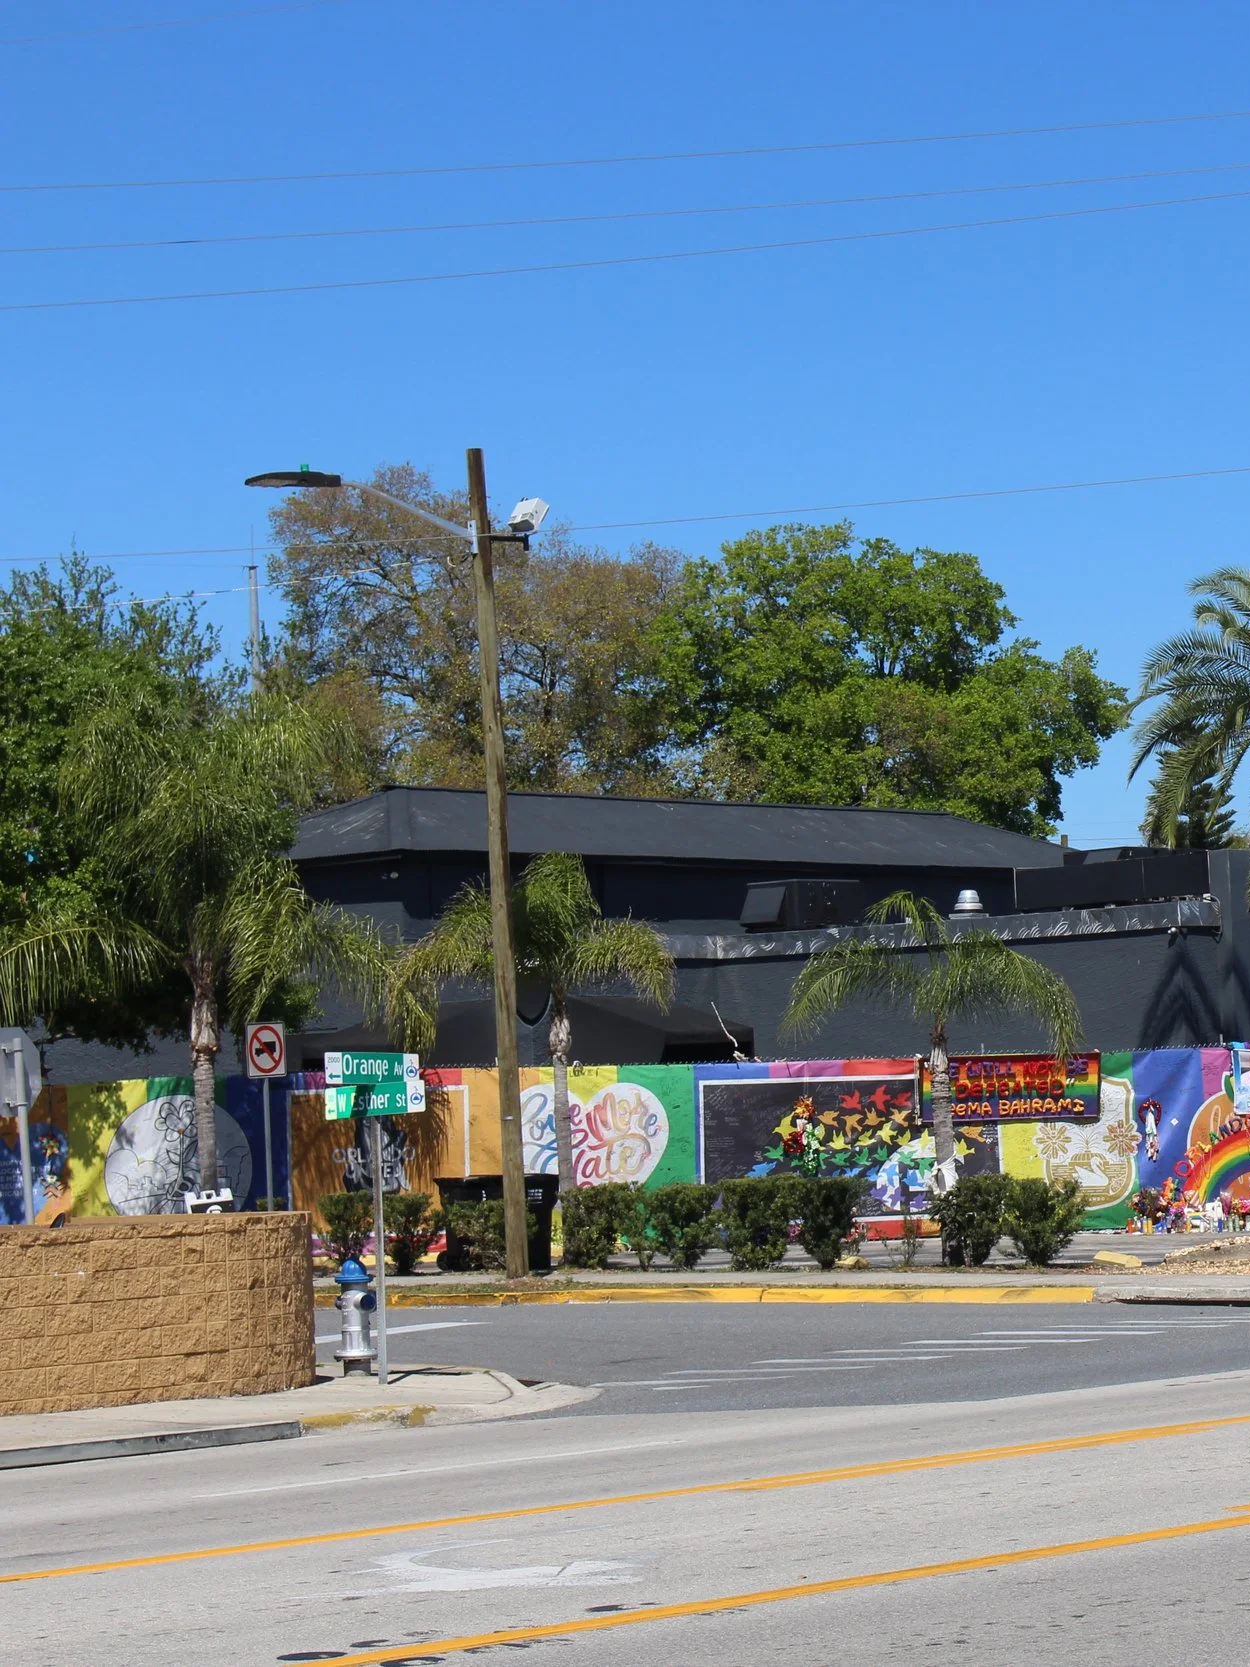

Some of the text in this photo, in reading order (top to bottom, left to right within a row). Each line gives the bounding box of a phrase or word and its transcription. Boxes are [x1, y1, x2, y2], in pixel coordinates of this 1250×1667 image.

[343, 1054, 404, 1082] Orange Av
[967, 1061, 1016, 1077] WILL
[337, 1093, 347, 1112] W
[351, 1092, 391, 1111] Esther
[396, 1093, 406, 1107] St
[999, 1098, 1085, 1115] BAHRAMI
[332, 1144, 416, 1164] ORLNDO
